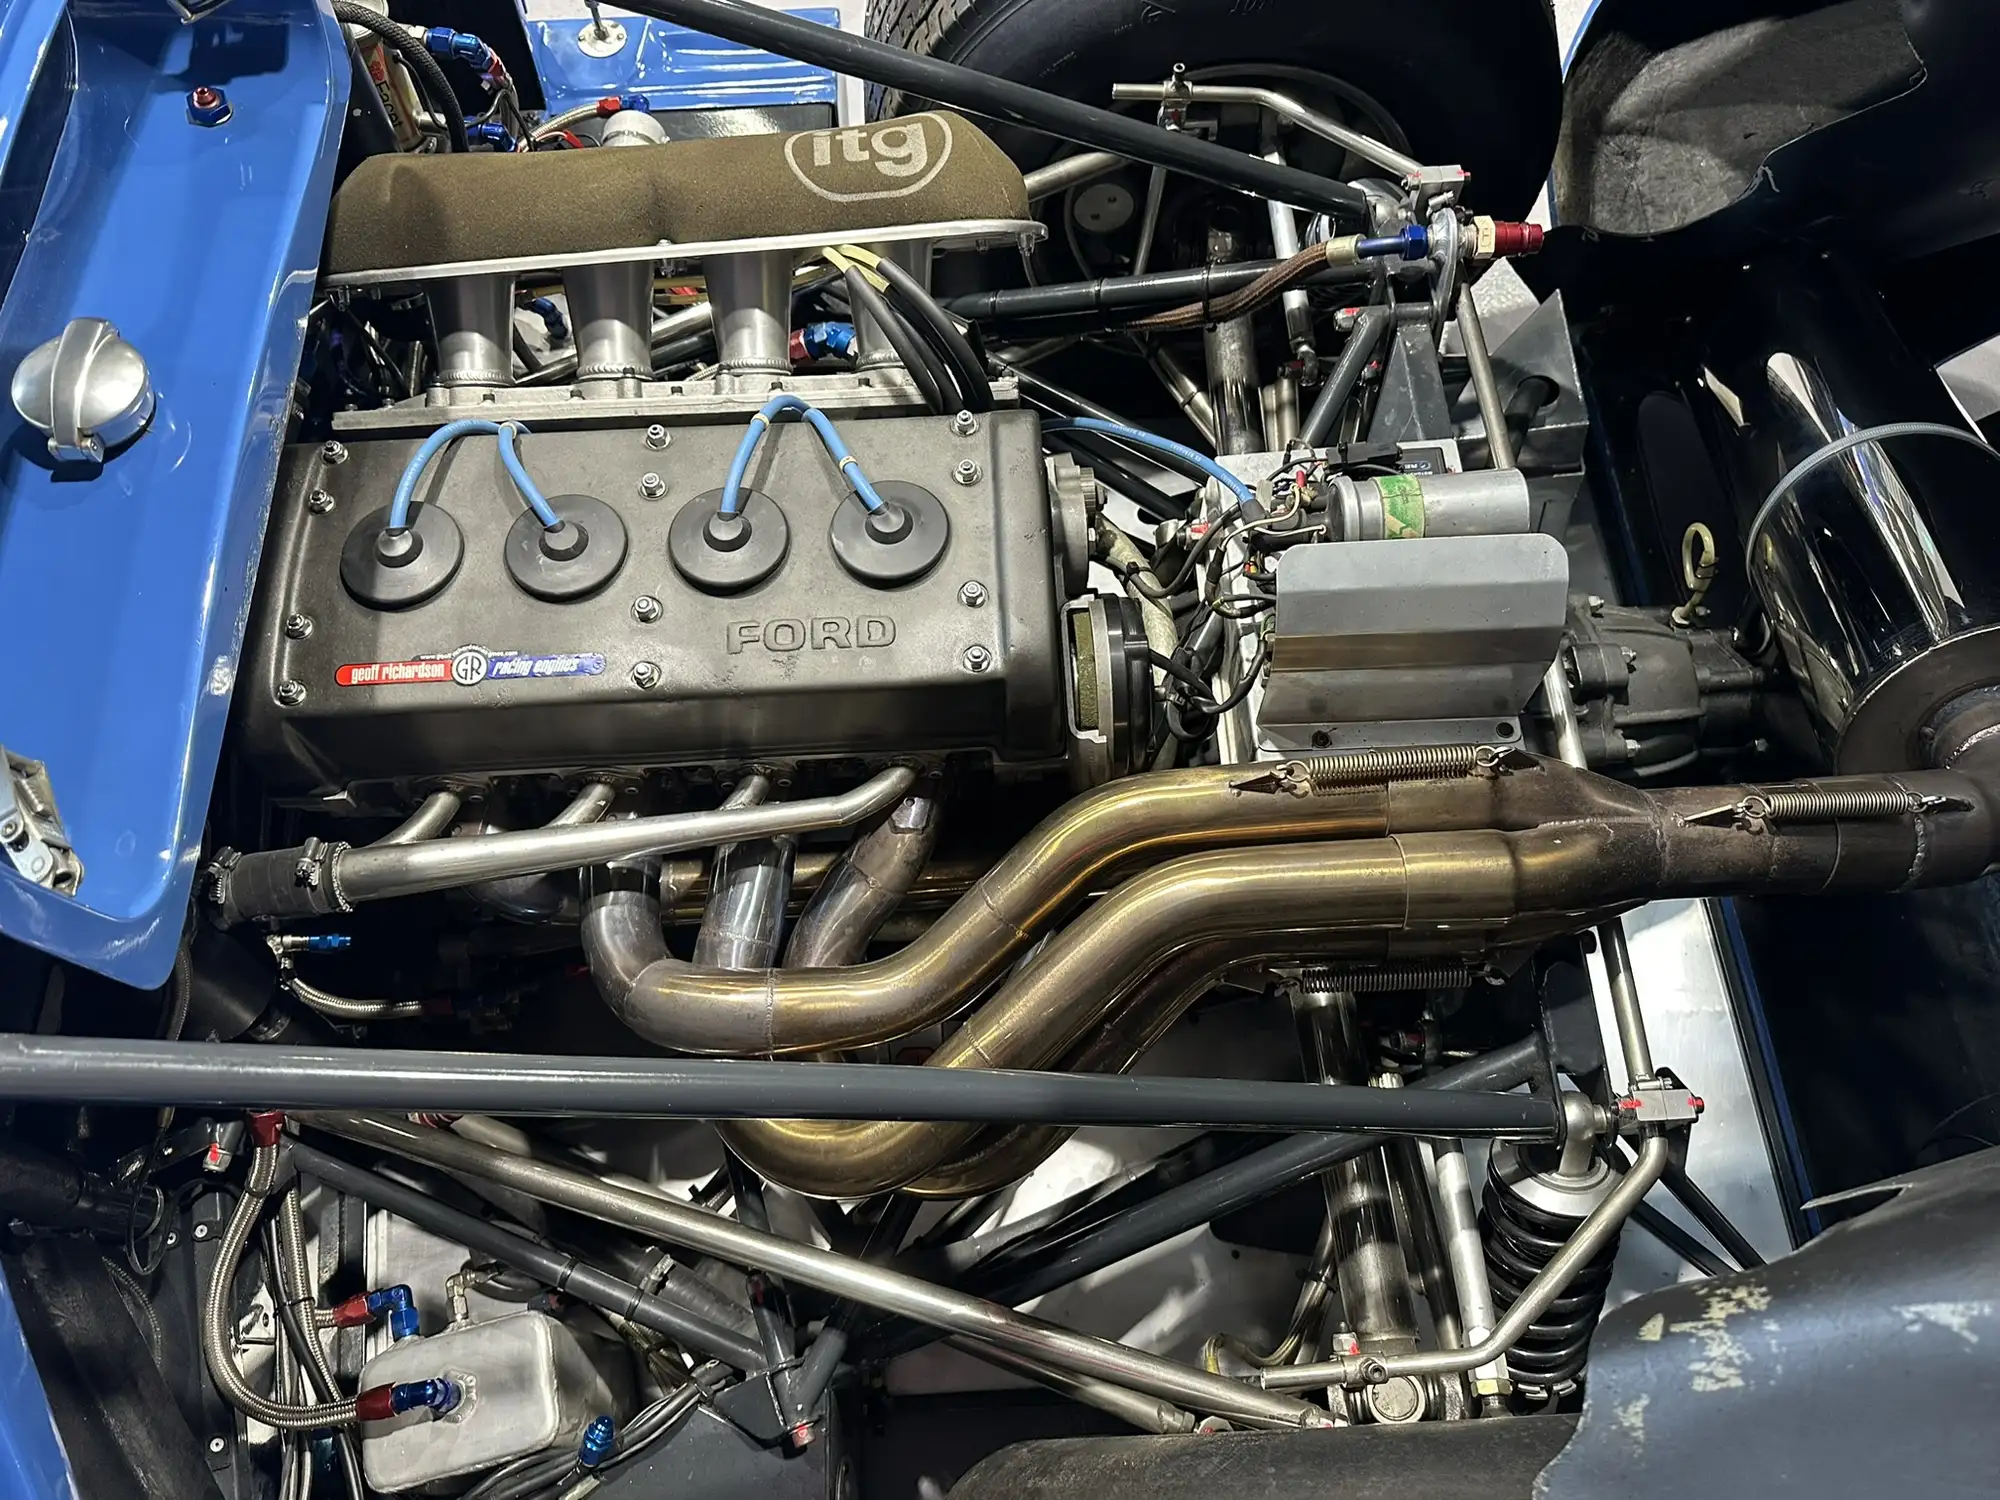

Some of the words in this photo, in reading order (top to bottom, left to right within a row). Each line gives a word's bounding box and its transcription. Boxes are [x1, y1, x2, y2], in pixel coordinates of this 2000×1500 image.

[375, 81, 403, 128] Facet
[812, 122, 928, 177] itg
[726, 615, 897, 655] FORD
[351, 663, 379, 685] geoff
[381, 662, 445, 680] richardson
[456, 656, 482, 680] GR
[492, 658, 533, 677] racing
[533, 657, 581, 675] engines
